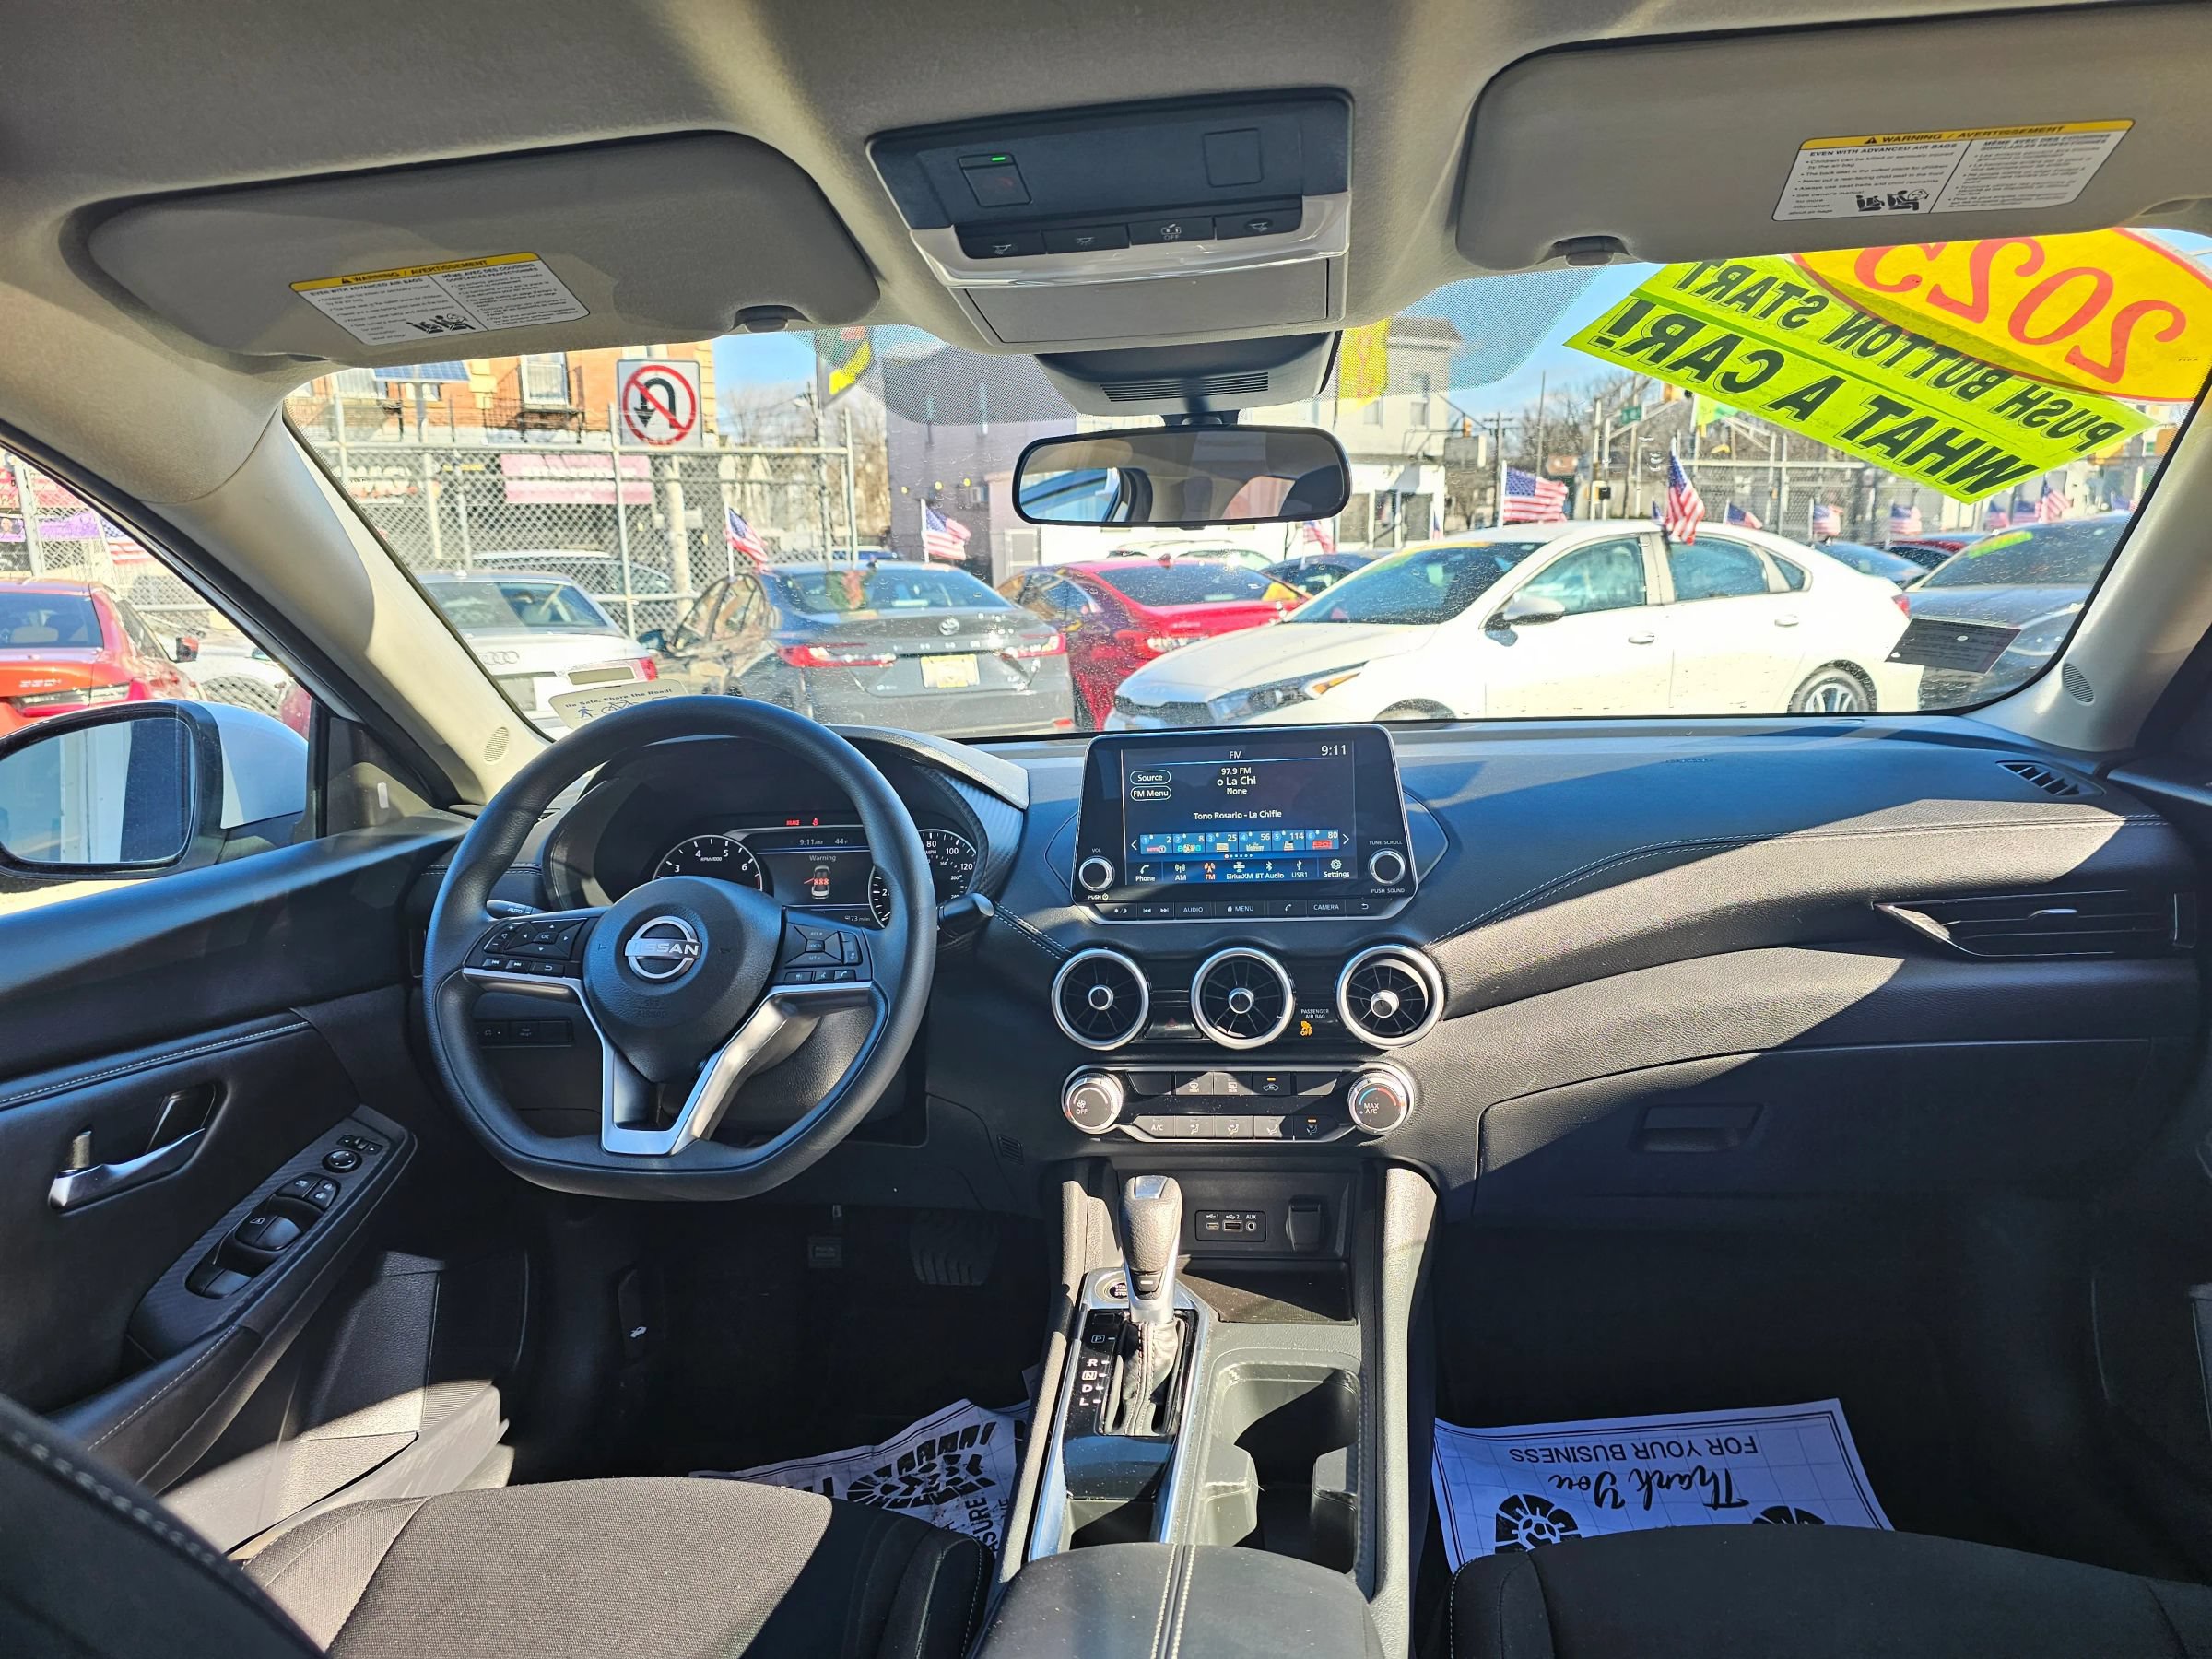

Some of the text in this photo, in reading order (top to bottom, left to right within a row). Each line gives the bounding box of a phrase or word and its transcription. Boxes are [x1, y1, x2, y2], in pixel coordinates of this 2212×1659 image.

[1882, 134, 1942, 143] WARNING
[1959, 126, 2065, 138] AVERTISSEMENT
[1229, 750, 1242, 759] FM
[1321, 745, 1347, 756] 9:11
[1220, 767, 1237, 775] 97.9
[1226, 776, 1238, 785] La
[1240, 775, 1256, 785] Chi
[1214, 811, 1242, 819] Rosario
[926, 840, 937, 848] 80
[695, 849, 701, 857] 4
[723, 849, 729, 857] 5
[674, 865, 680, 873] 3
[741, 863, 747, 871] 6
[1226, 872, 1253, 880] SiriusXM
[1081, 1383, 1093, 1393] D
[1079, 1397, 1089, 1406] L
[1510, 1435, 1759, 1463] FOR YOUR BUSINESS
[1548, 1465, 1749, 1511] Thank You
